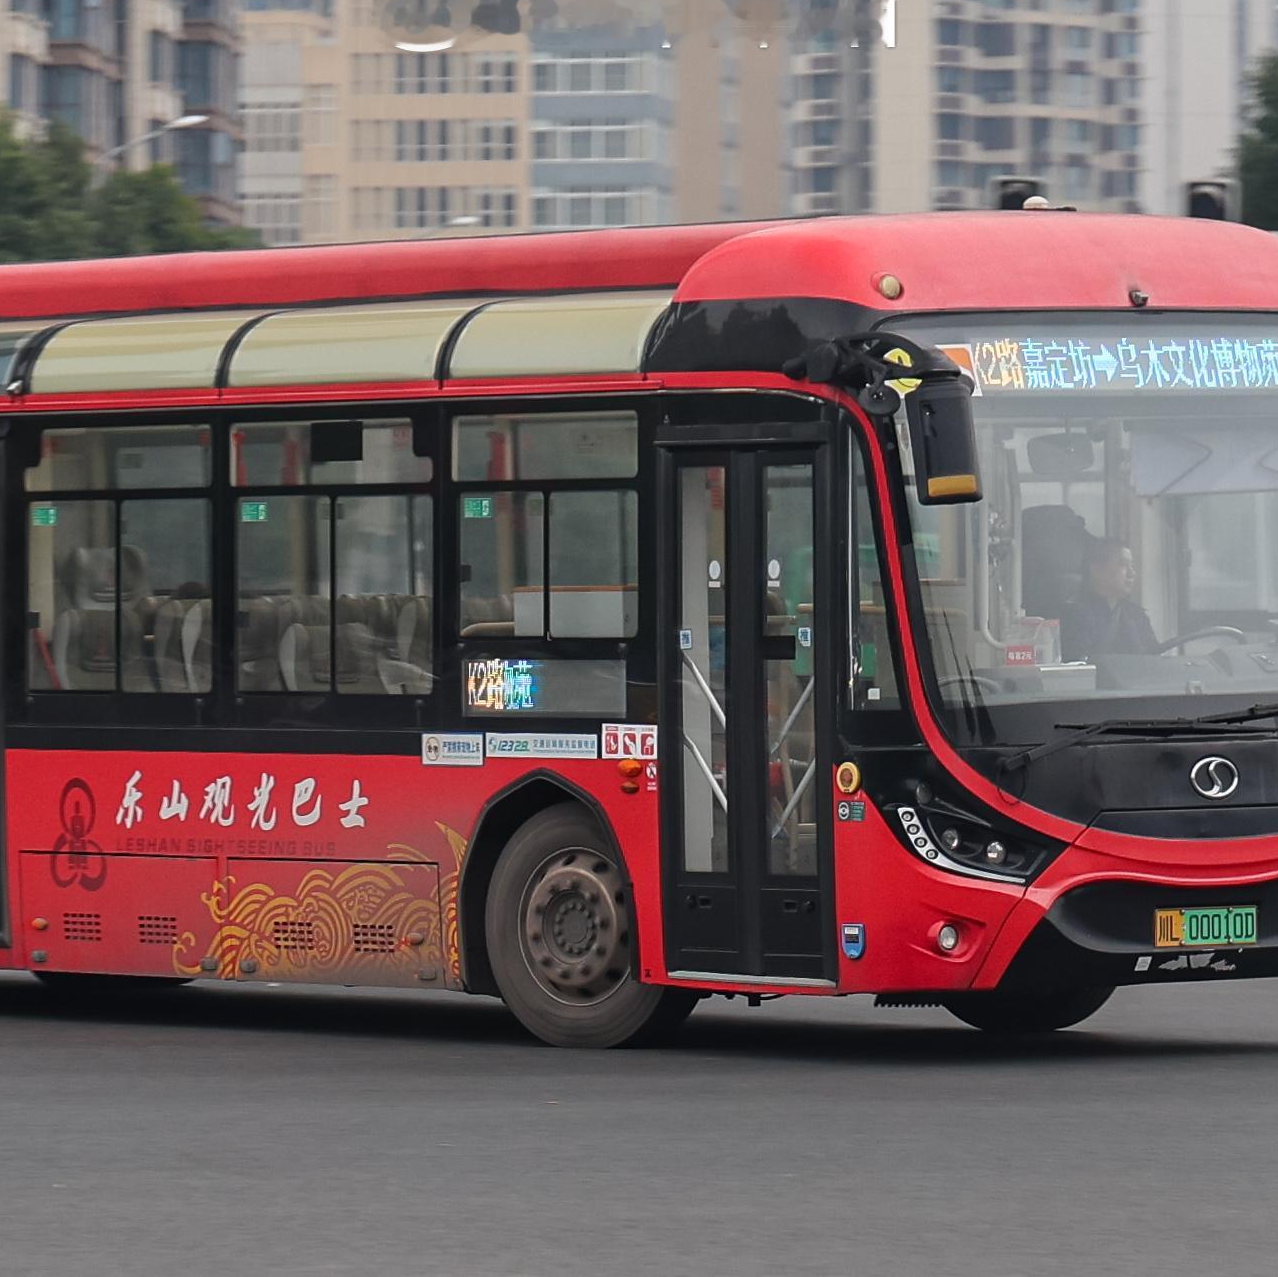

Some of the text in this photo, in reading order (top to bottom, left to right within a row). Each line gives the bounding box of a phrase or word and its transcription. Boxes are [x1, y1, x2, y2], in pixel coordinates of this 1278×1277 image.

[115, 770, 370, 830] 乐山观光巴士
[116, 837, 336, 857] LESHAN SIGHTSEEING BUS
